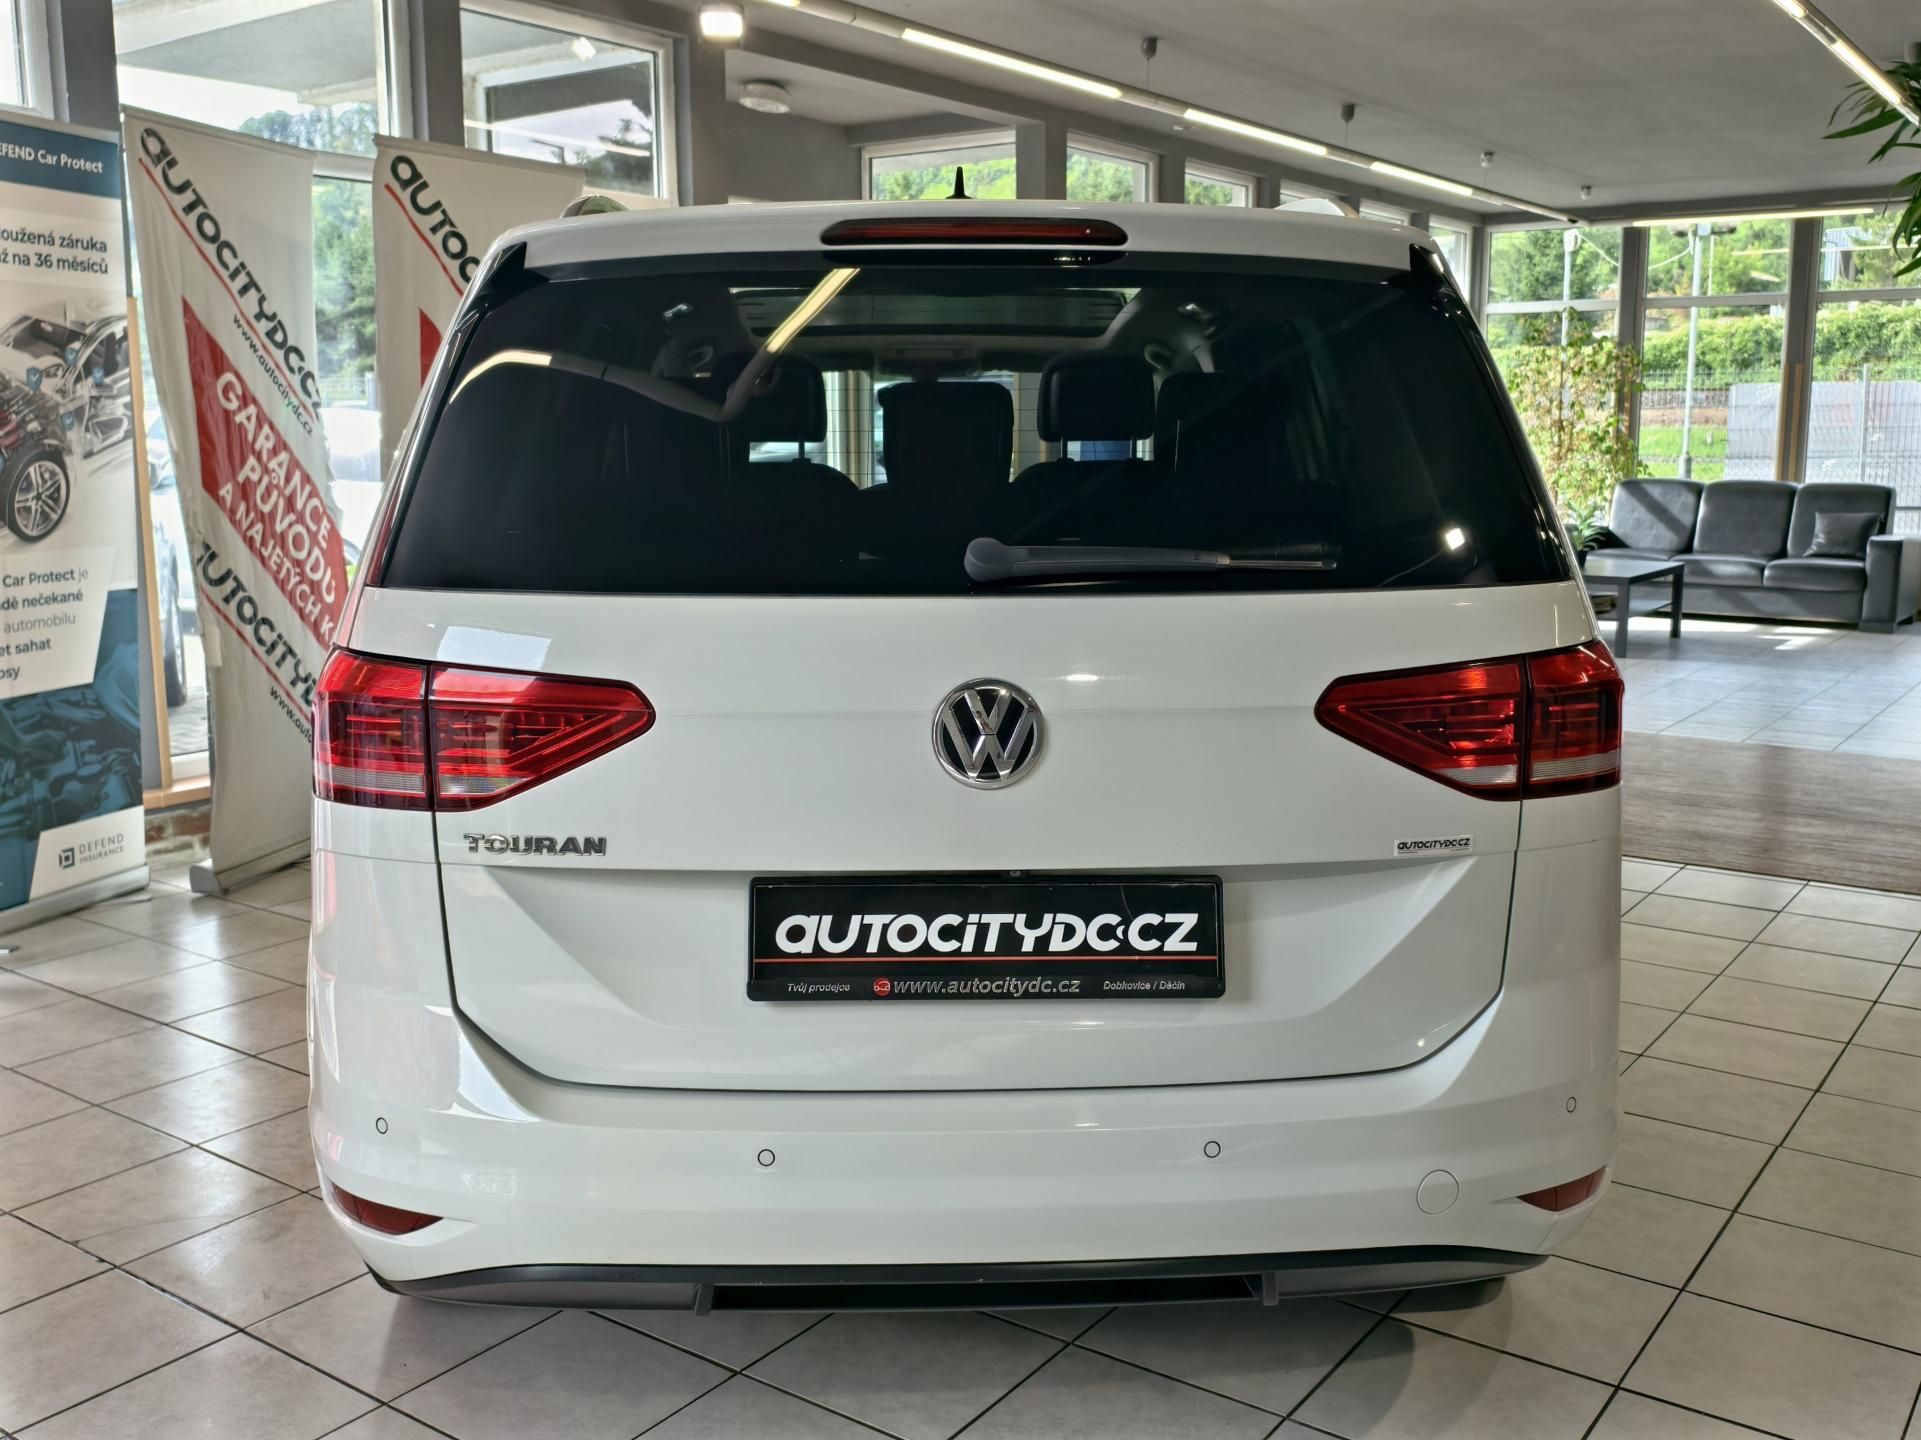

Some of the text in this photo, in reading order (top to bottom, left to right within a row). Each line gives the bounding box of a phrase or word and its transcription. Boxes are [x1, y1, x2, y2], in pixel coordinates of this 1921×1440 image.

[0, 141, 103, 173] FEND Car Protect
[391, 155, 480, 284] aUTOC
[0, 227, 107, 253] oužená záruka
[0, 247, 108, 274] ž na 36 měsíců
[216, 372, 331, 548] GARANCE
[237, 455, 335, 603] PŮVODU
[2, 568, 89, 588] Car Protect je
[0, 588, 84, 611] dě nečekané
[4, 611, 76, 634] automobilu
[320, 614, 334, 642] K
[0, 637, 52, 657] et sahat
[0, 665, 20, 681] osy
[270, 686, 312, 743] www.auto
[79, 833, 124, 856] DEFEND
[80, 846, 124, 865] INSURANCE
[464, 833, 607, 856] TOURAN
[808, 983, 850, 993] prodejce
[893, 977, 1081, 997] www.autocitydc.cz
[1103, 980, 1151, 990] Dobkovice
